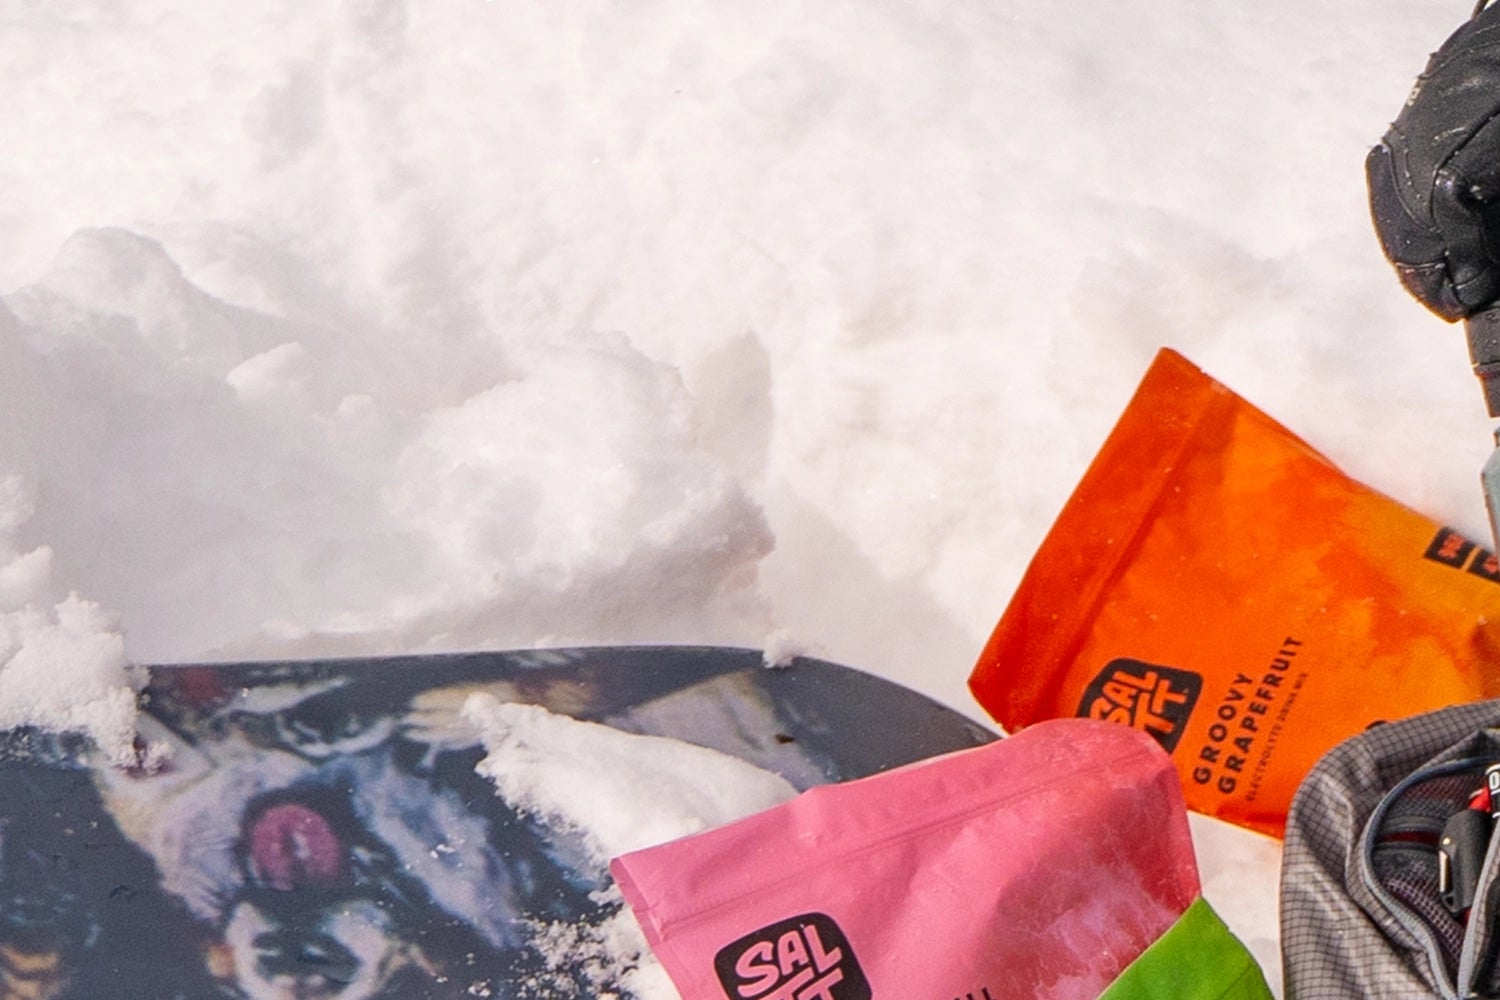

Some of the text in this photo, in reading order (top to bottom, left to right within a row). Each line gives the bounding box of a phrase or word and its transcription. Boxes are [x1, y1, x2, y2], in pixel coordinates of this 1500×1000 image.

[1090, 671, 1158, 725] SAL
[1134, 680, 1188, 733] TT
[1192, 673, 1254, 785] GROOVY
[1217, 636, 1303, 795] GRAPEFRUIT
[1246, 722, 1283, 801] ELECTROLYTE
[734, 924, 843, 998] SAL
